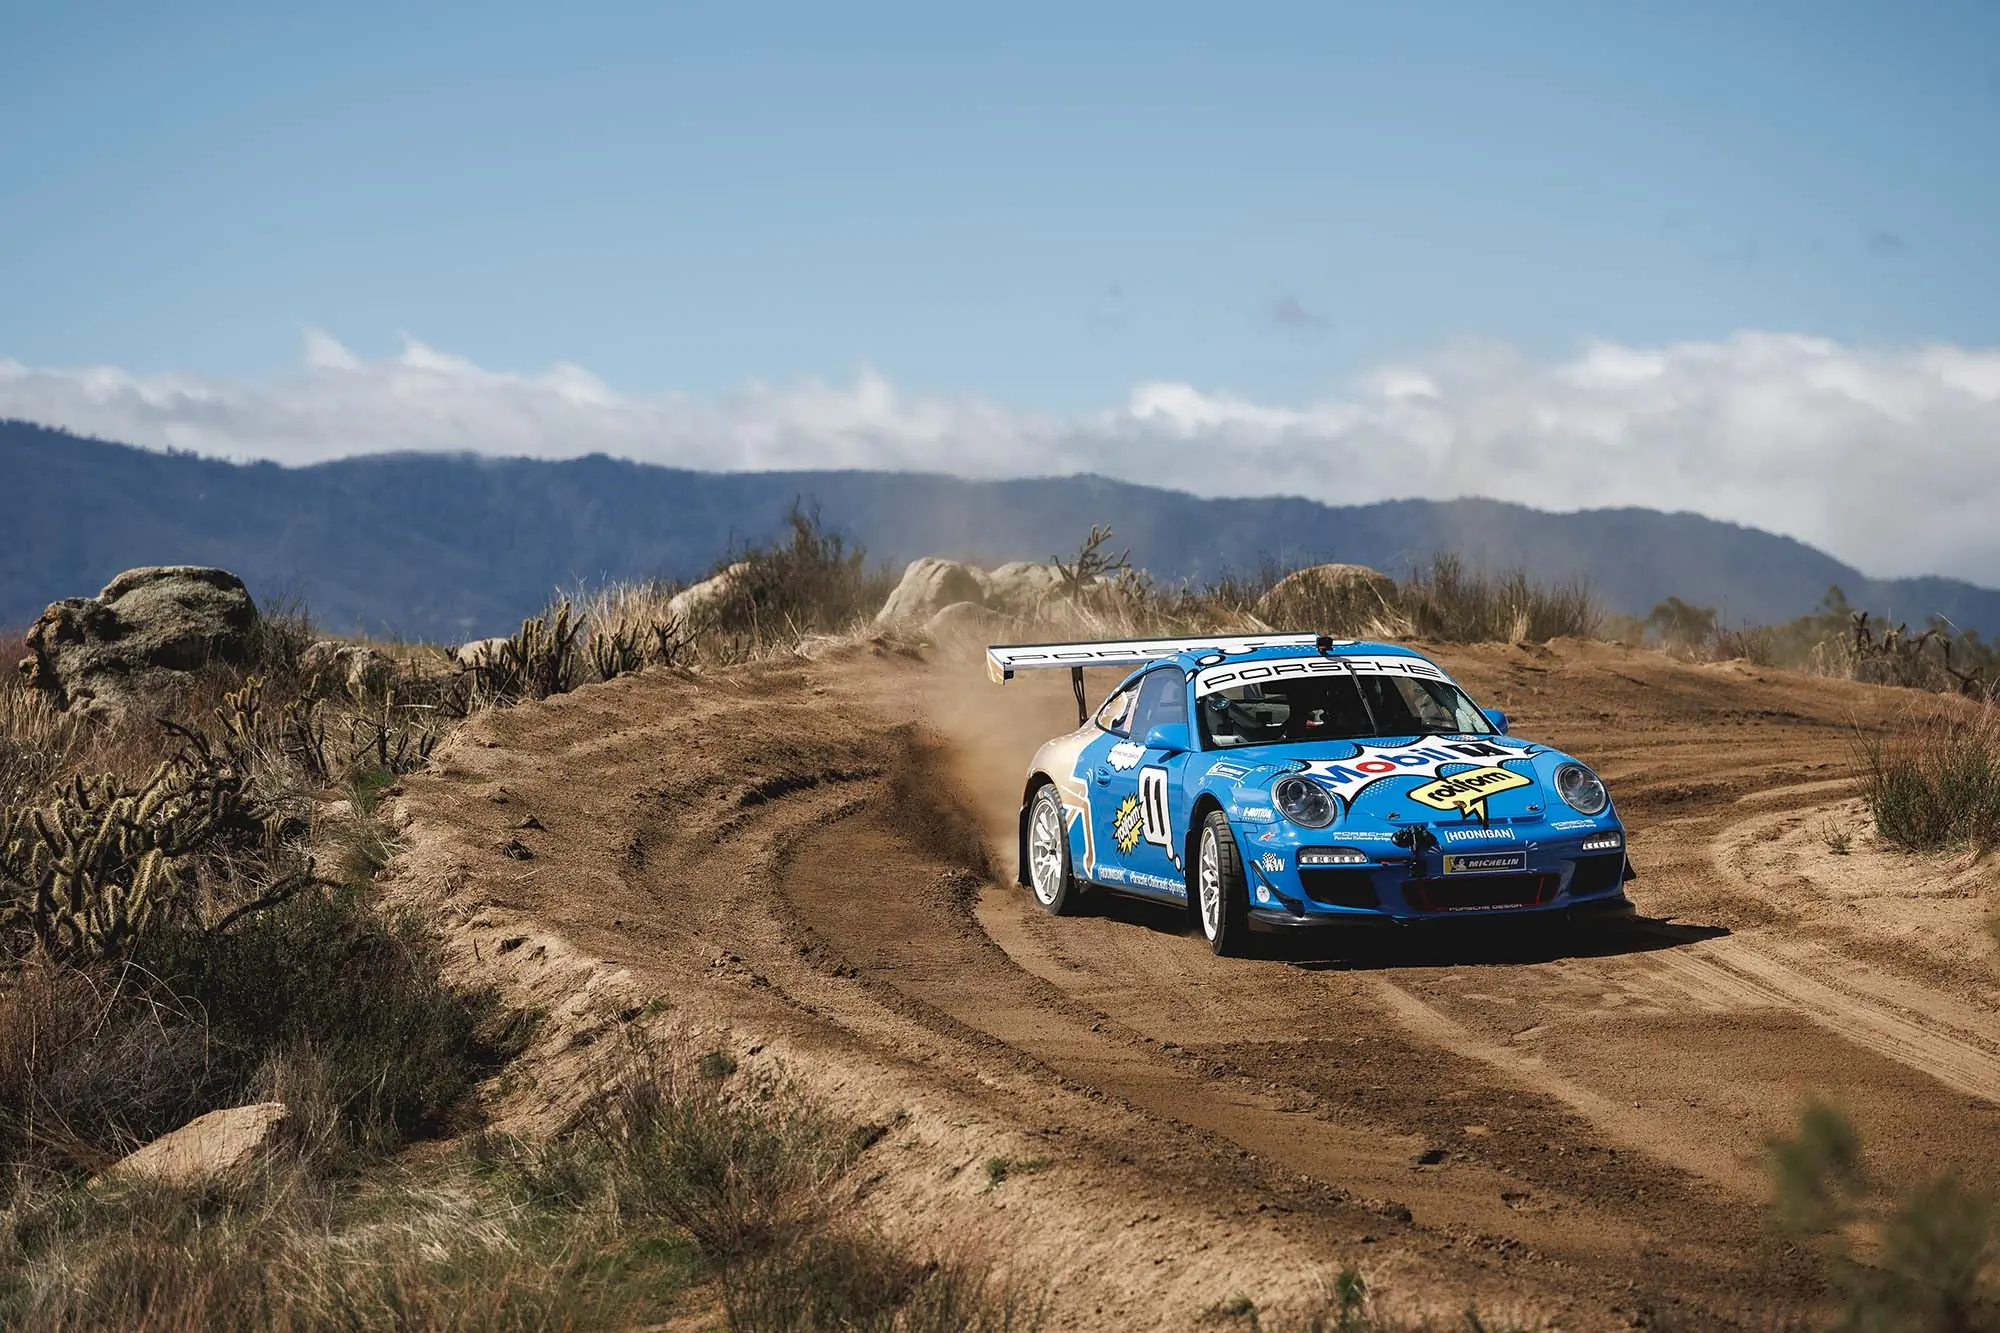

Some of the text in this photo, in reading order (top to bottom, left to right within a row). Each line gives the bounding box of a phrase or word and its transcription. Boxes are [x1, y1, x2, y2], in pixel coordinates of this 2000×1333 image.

[1203, 661, 1442, 690] PORSCHE
[1304, 746, 1461, 790] Mobil
[1427, 771, 1513, 802] rotiform
[1143, 776, 1166, 837] 11
[1266, 857, 1286, 872] KW
[1468, 858, 1520, 868] MICHELIN
